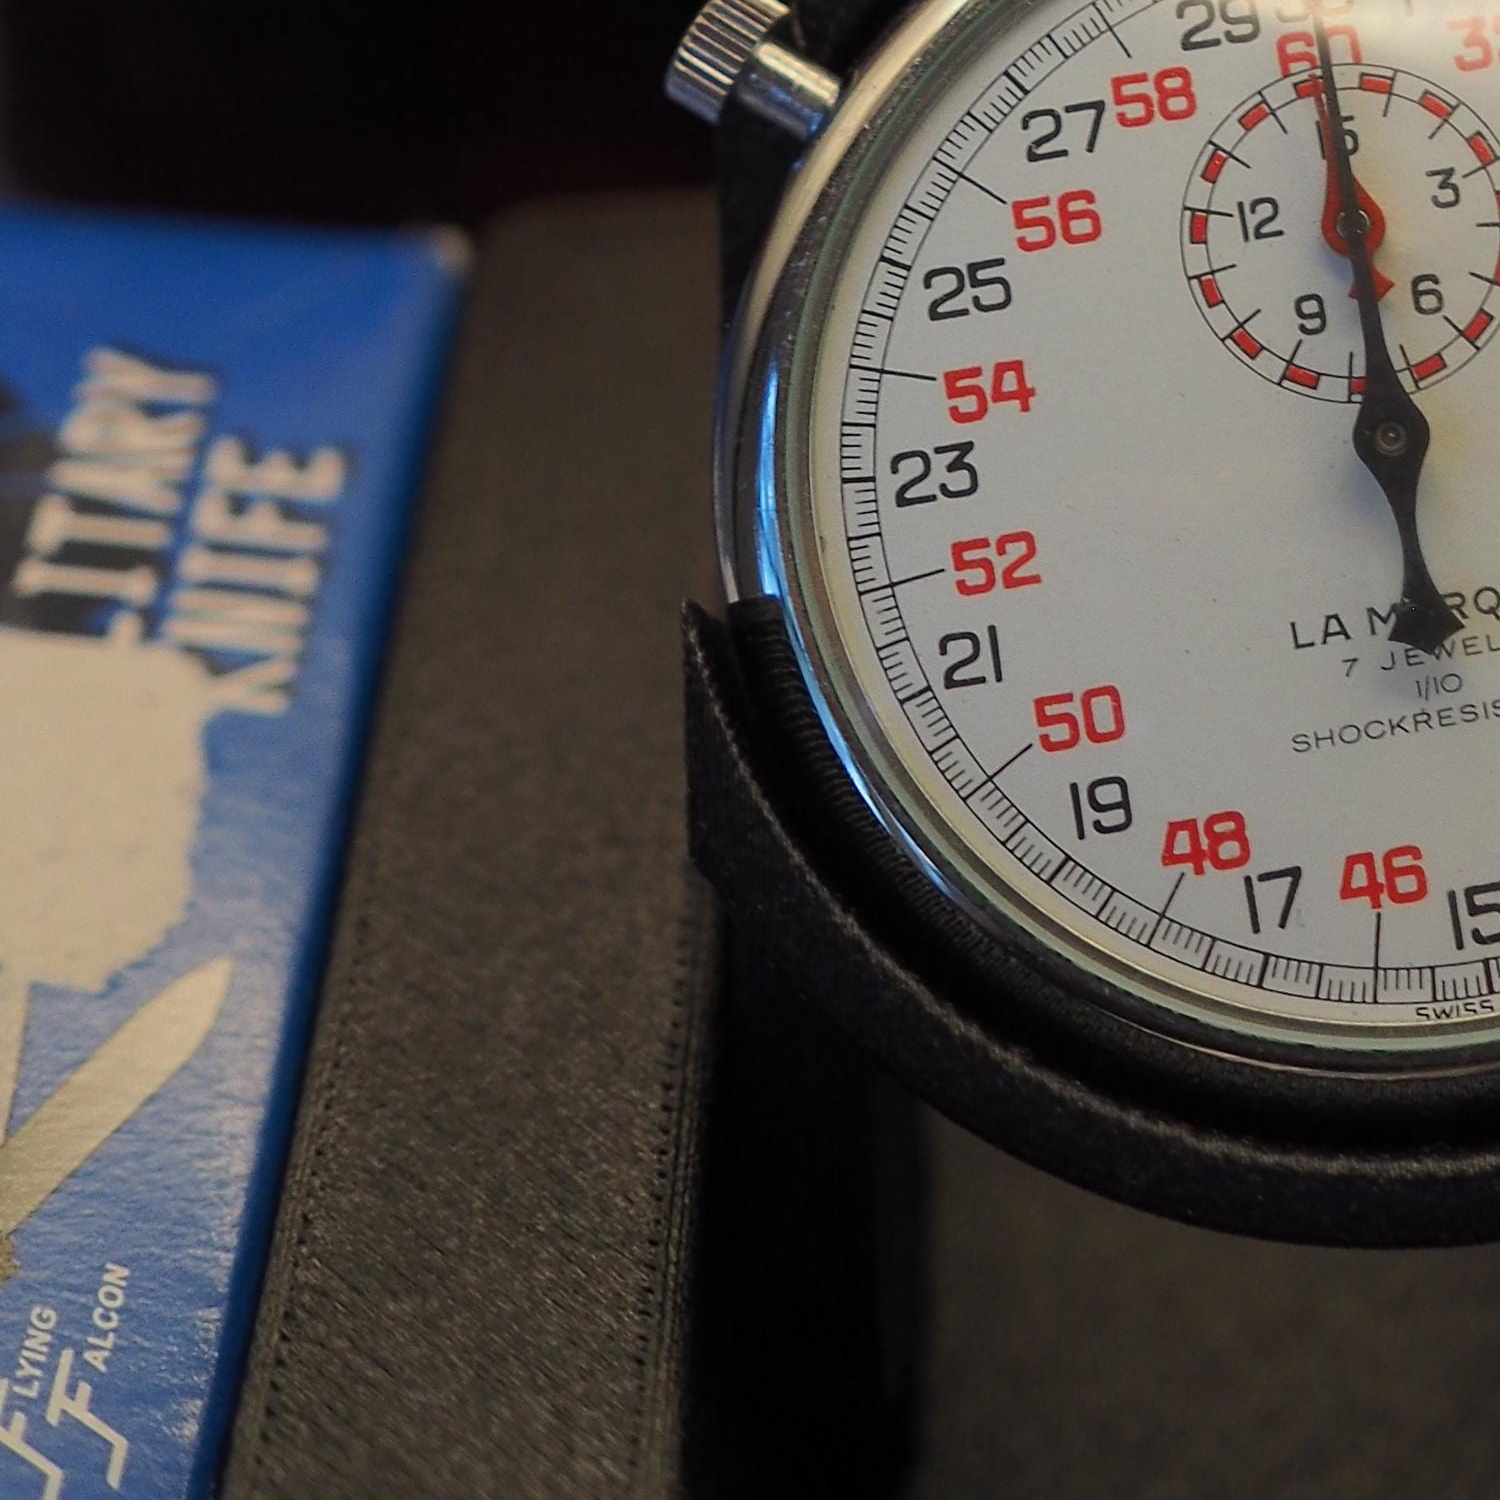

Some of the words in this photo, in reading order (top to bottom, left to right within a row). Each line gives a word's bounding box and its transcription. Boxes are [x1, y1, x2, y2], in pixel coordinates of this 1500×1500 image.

[1110, 66, 1197, 128] 58
[1021, 100, 1105, 161] 27
[1426, 167, 1461, 208] 3
[1011, 189, 1101, 252] 56
[1237, 197, 1284, 242] 12
[923, 258, 1012, 321] 25
[1294, 293, 1327, 335] 9
[1410, 274, 1444, 315] 6
[943, 360, 1035, 423] 54
[12, 346, 217, 646] ITARY
[890, 441, 979, 507] 23
[162, 434, 348, 716] KNIFE
[950, 530, 1041, 596] 52
[938, 625, 1003, 689] 21
[1290, 612, 1351, 650] LA
[1341, 658, 1359, 678] 7
[1416, 672, 1463, 701] 1/10
[1034, 684, 1126, 753] 50
[1069, 775, 1133, 840] 19
[1161, 810, 1252, 876] 48
[1243, 866, 1303, 934] 17
[1339, 845, 1428, 910] 46
[1415, 999, 1495, 1021] SWISS
[45, 1261, 130, 1491] FALCON
